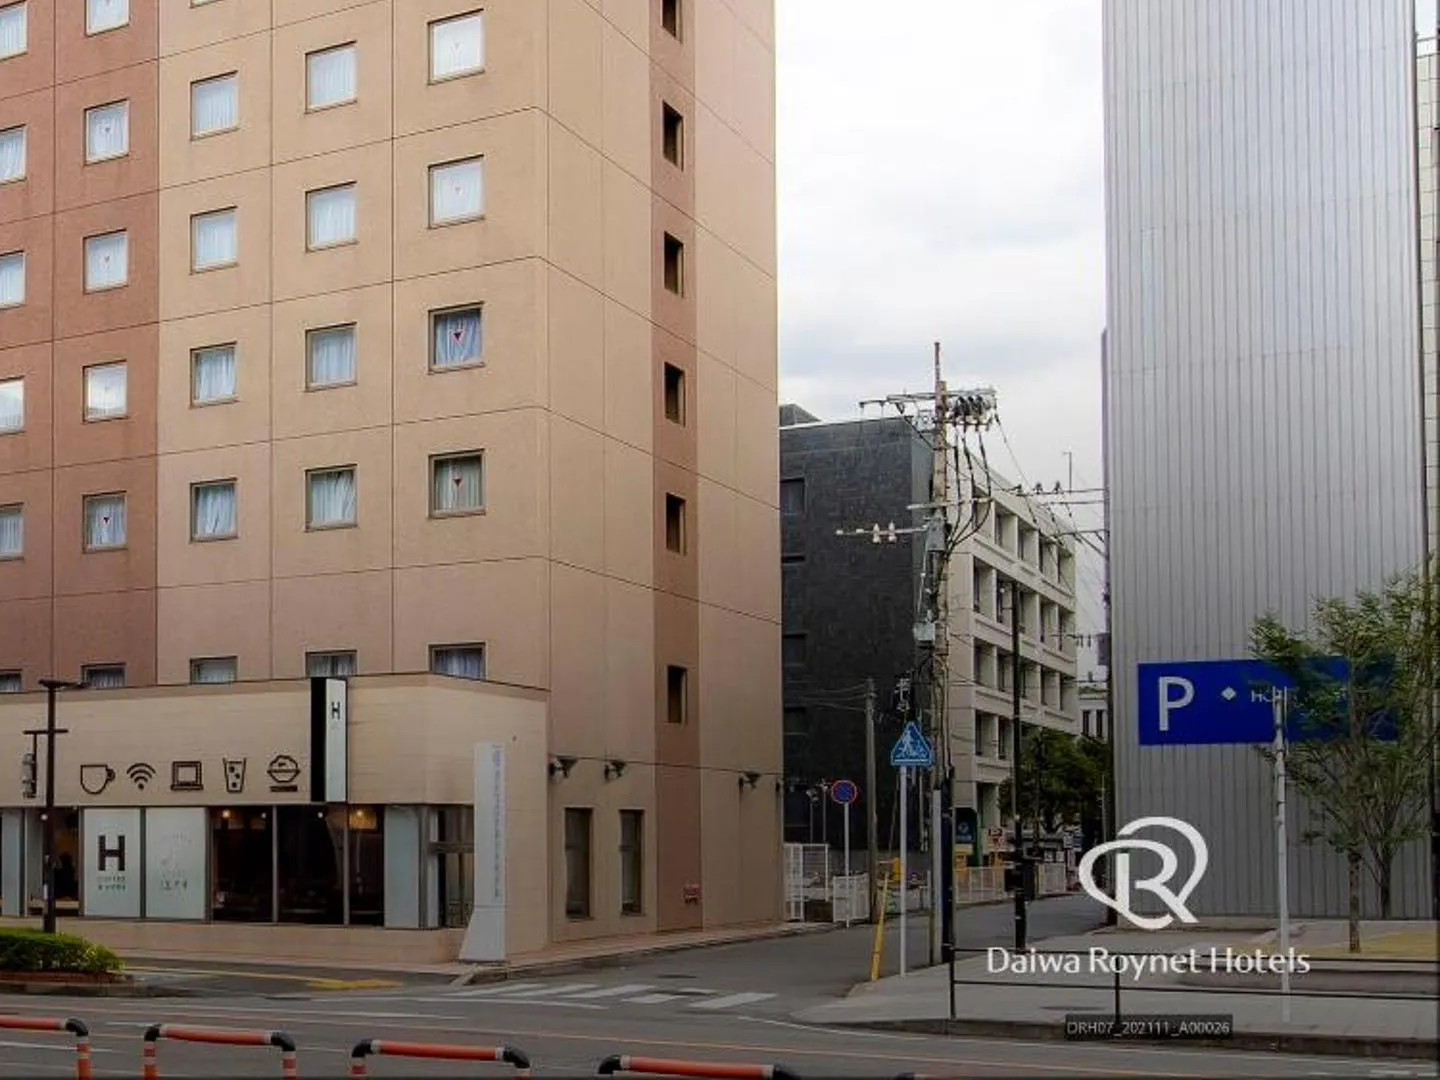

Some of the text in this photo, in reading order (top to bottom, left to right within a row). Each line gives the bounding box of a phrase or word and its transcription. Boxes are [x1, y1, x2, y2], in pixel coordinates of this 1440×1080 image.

[331, 701, 341, 720] H
[1158, 676, 1196, 732] P
[98, 835, 125, 871] H
